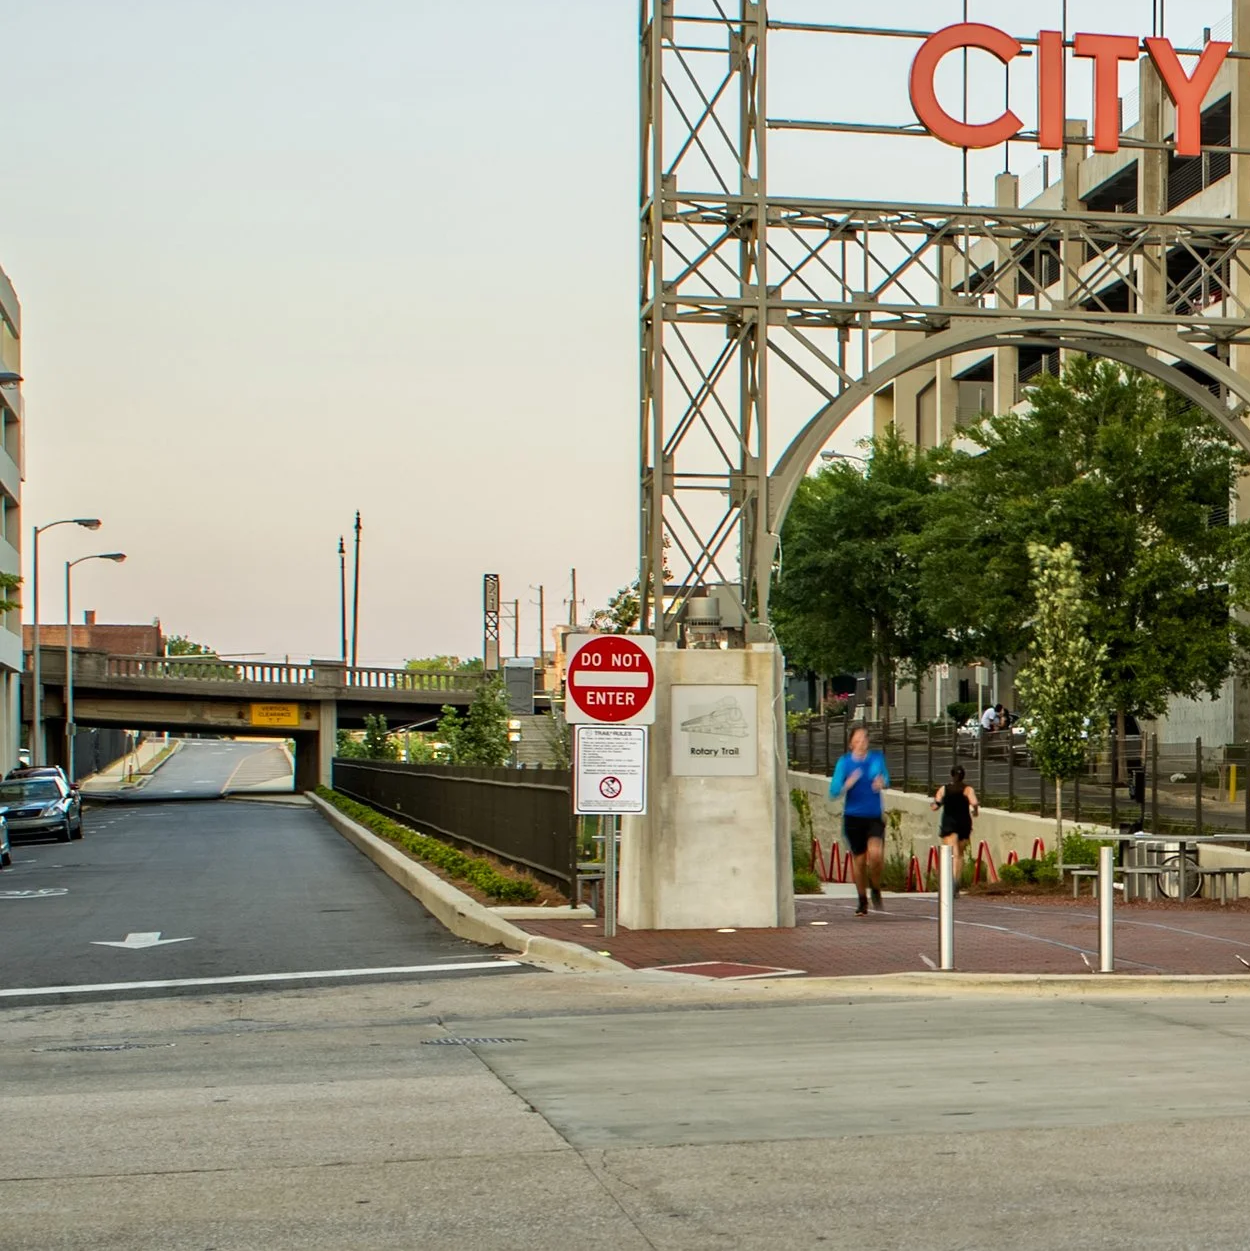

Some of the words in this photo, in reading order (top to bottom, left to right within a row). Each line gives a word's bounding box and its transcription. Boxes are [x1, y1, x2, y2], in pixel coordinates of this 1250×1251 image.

[909, 22, 1232, 157] CITY
[581, 652, 602, 667] DO
[611, 653, 642, 667] NOT
[586, 691, 635, 706] ENTER
[690, 747, 719, 757] Rotary
[721, 747, 740, 755] Trail
